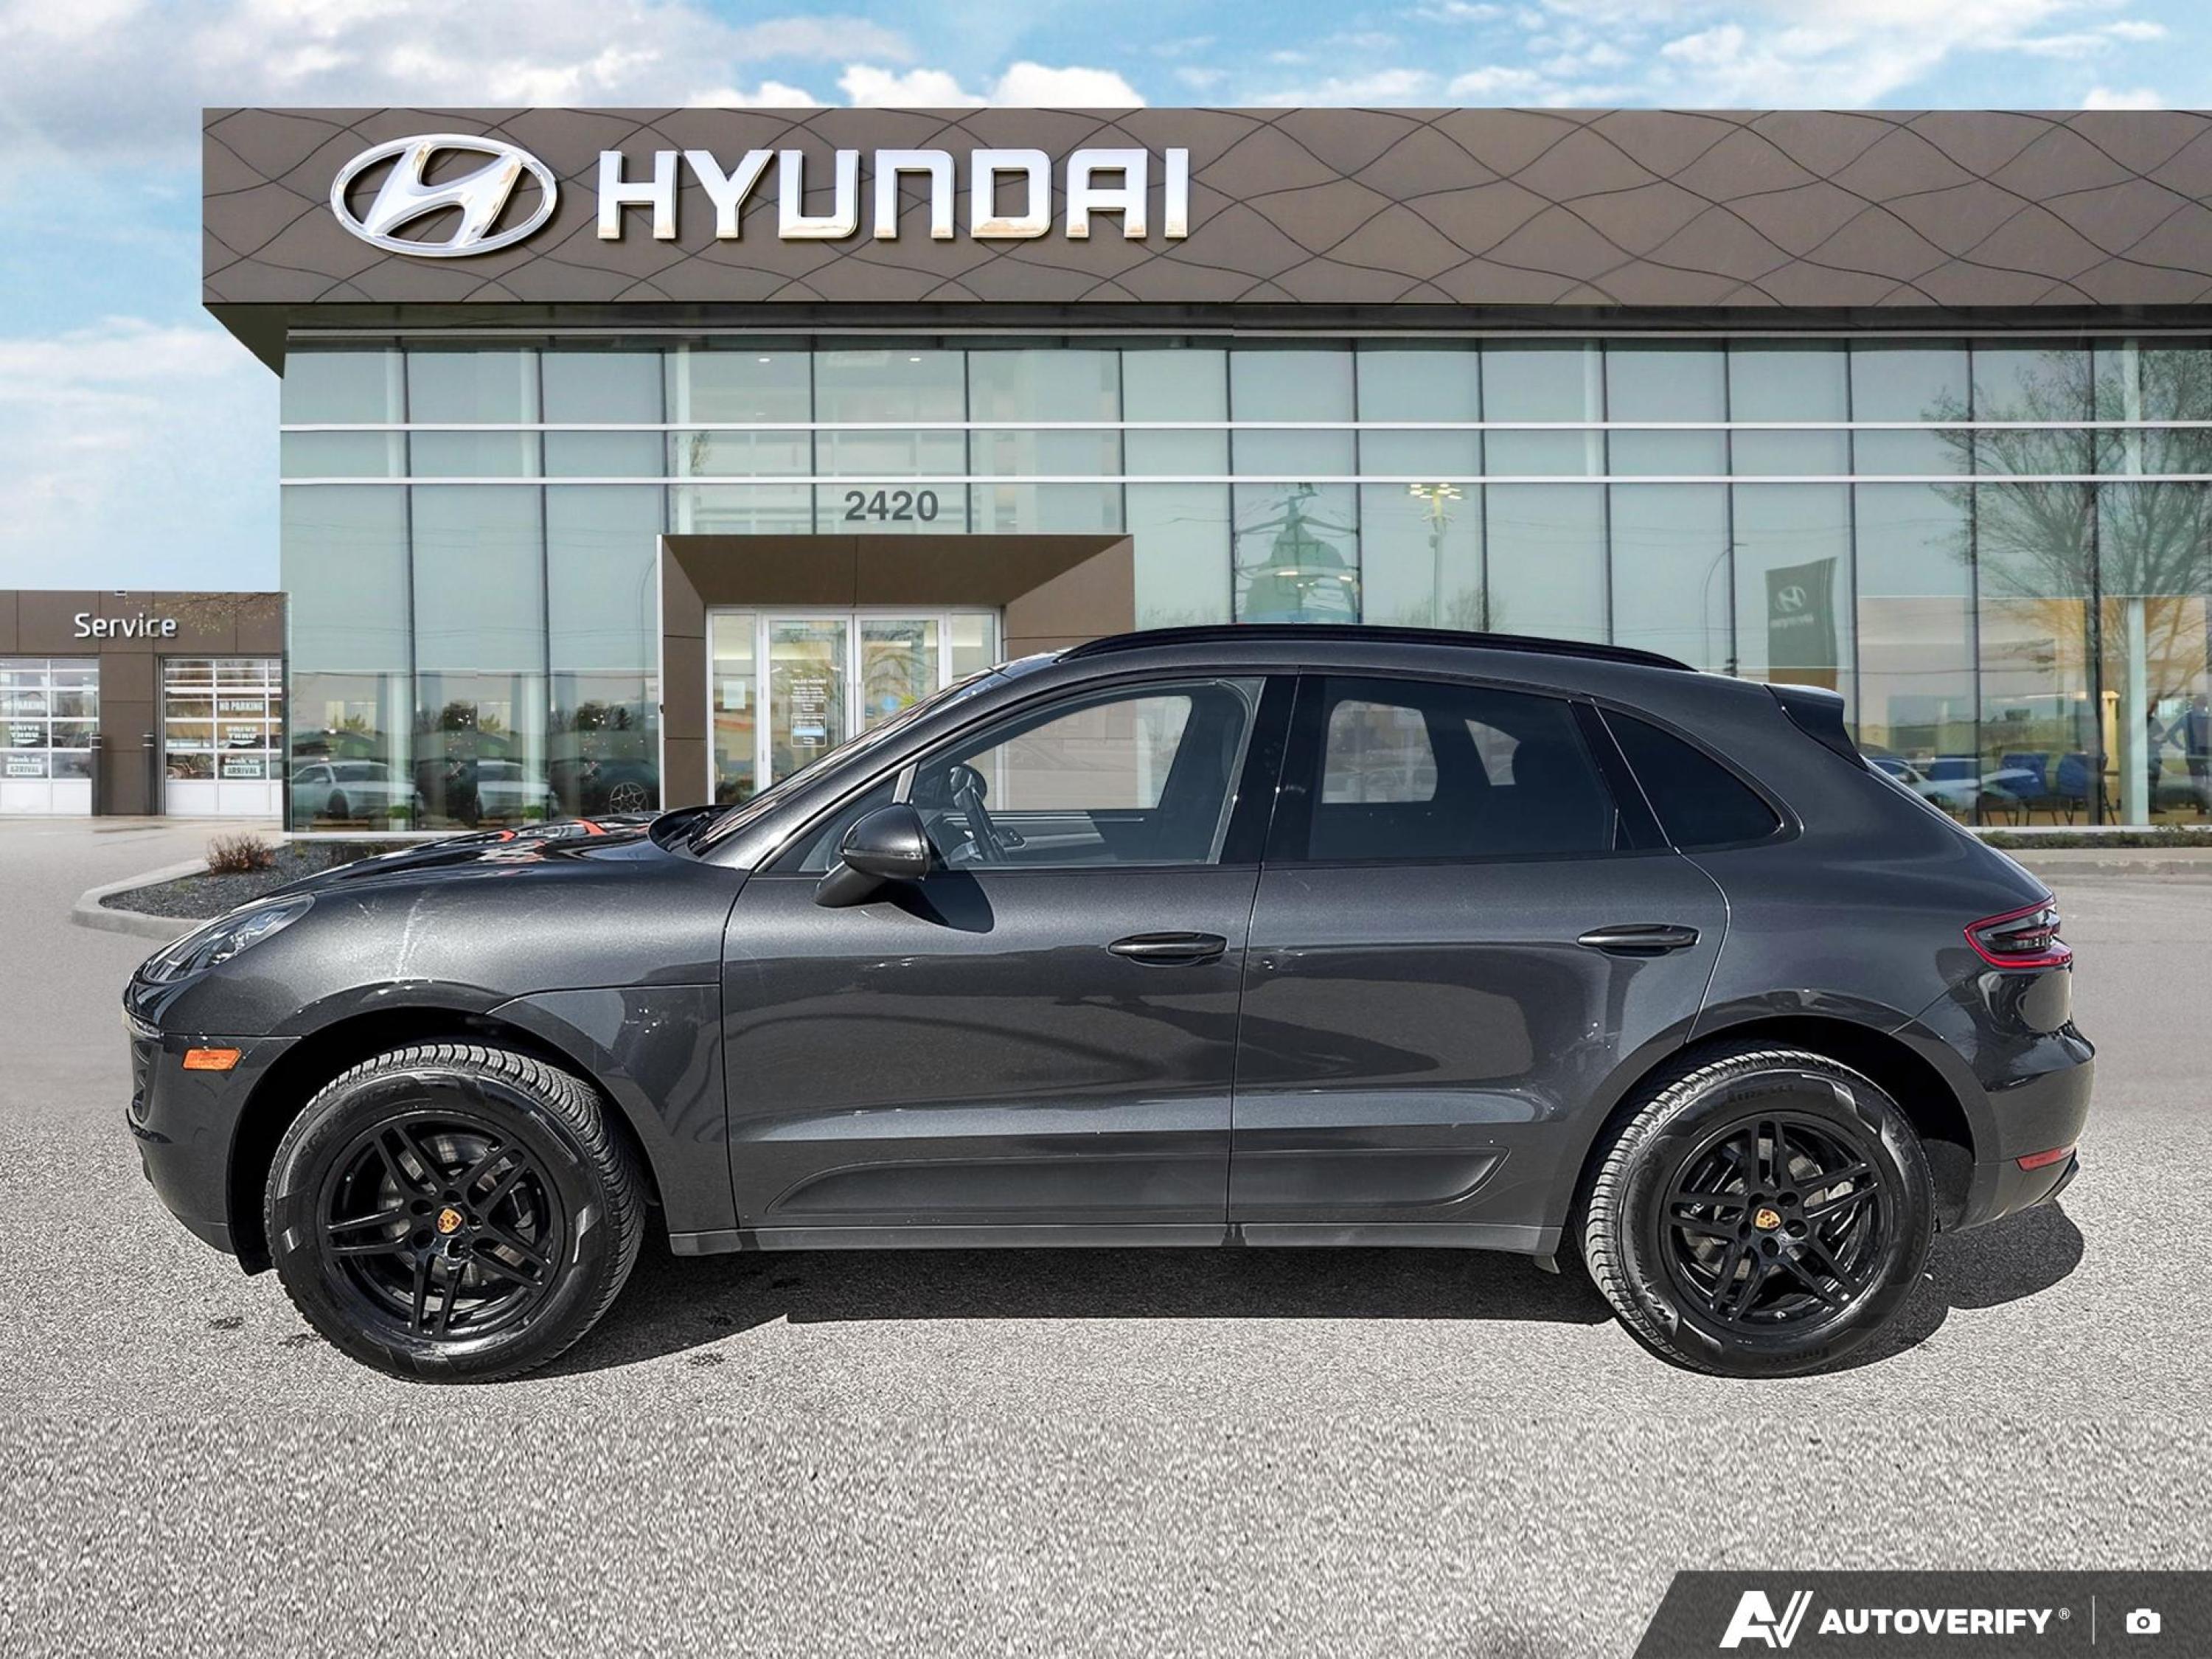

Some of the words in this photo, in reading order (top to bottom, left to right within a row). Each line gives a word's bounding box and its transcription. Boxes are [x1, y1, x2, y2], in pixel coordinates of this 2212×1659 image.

[598, 149, 1189, 239] HYUNDAI
[845, 490, 939, 521] 2420
[74, 612, 177, 638] Service
[227, 766, 257, 774] ARRIVAL
